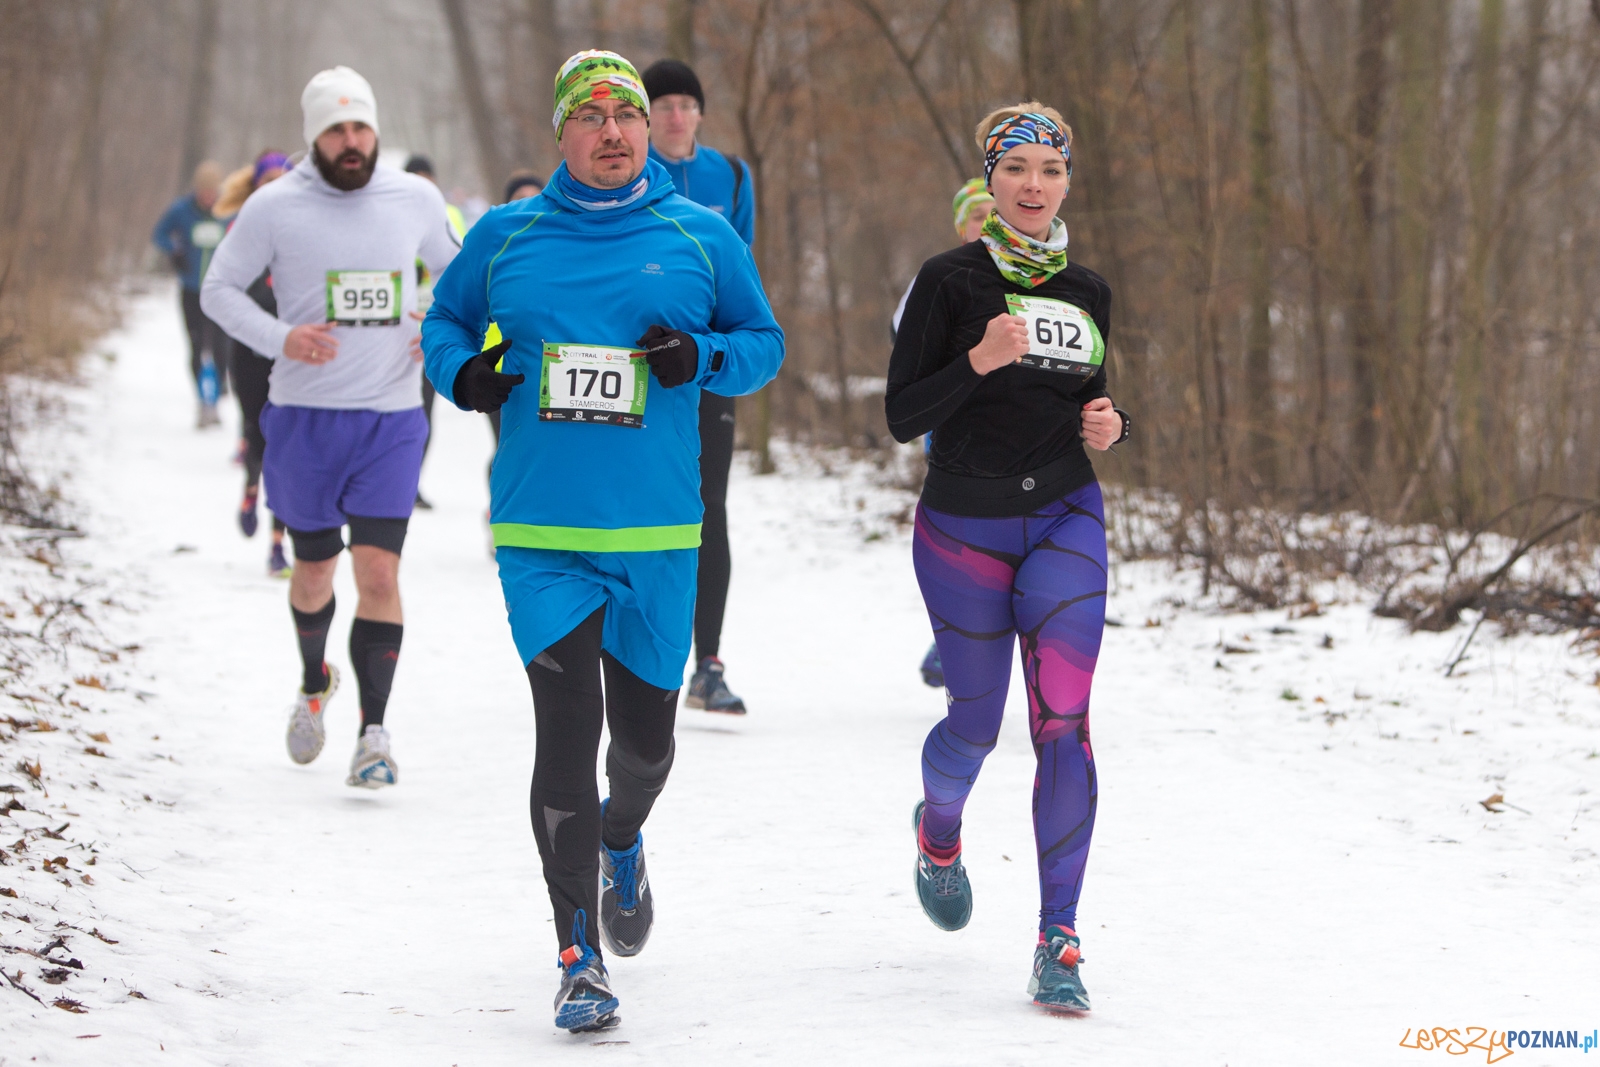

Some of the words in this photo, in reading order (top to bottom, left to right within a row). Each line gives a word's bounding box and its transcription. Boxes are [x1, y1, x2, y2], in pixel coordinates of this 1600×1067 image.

[343, 289, 389, 310] 959
[1035, 317, 1082, 350] 612
[1045, 348, 1071, 359] DOROTA
[566, 368, 622, 400] 170
[569, 400, 615, 410] STAMPEROS
